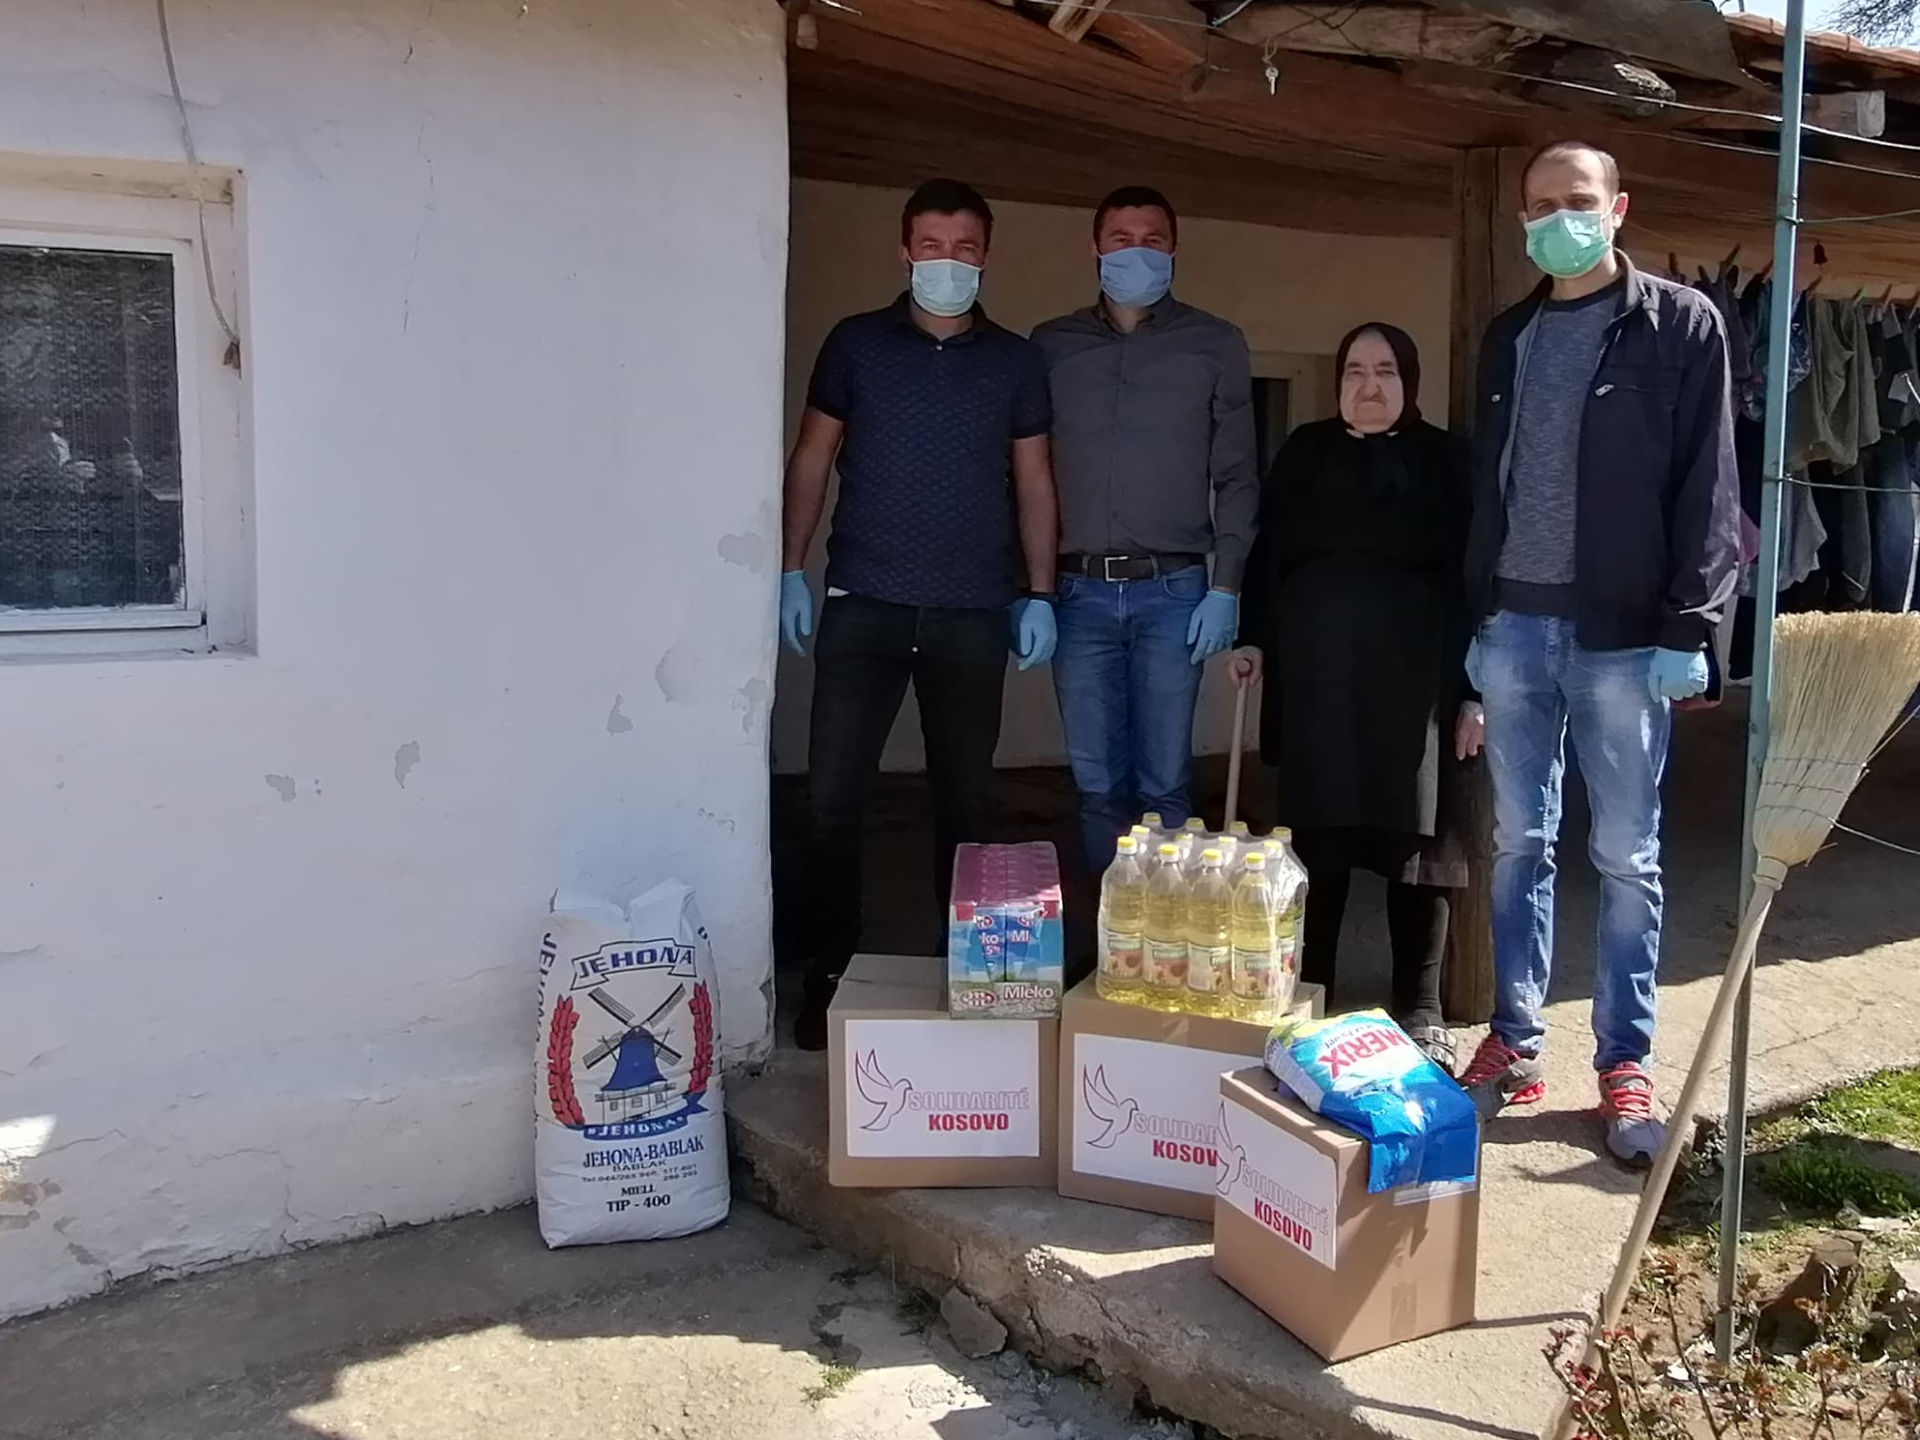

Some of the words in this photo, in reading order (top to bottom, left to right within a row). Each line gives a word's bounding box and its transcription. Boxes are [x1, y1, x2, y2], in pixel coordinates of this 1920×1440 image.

[578, 946, 693, 978] JEHONA
[1004, 985, 1055, 999] Mleko
[1318, 1027, 1409, 1082] MERIX
[908, 1087, 1030, 1110] SOLIDARITÉ
[928, 1112, 1009, 1132] KOSOVO
[1152, 1140, 1218, 1167] KOSOV
[612, 1160, 668, 1173] BABLAK
[606, 1199, 631, 1212] TIP
[643, 1194, 671, 1209] 400
[1242, 1163, 1330, 1237] SOLIDARITÉ
[1254, 1197, 1313, 1252] KOSOVO
